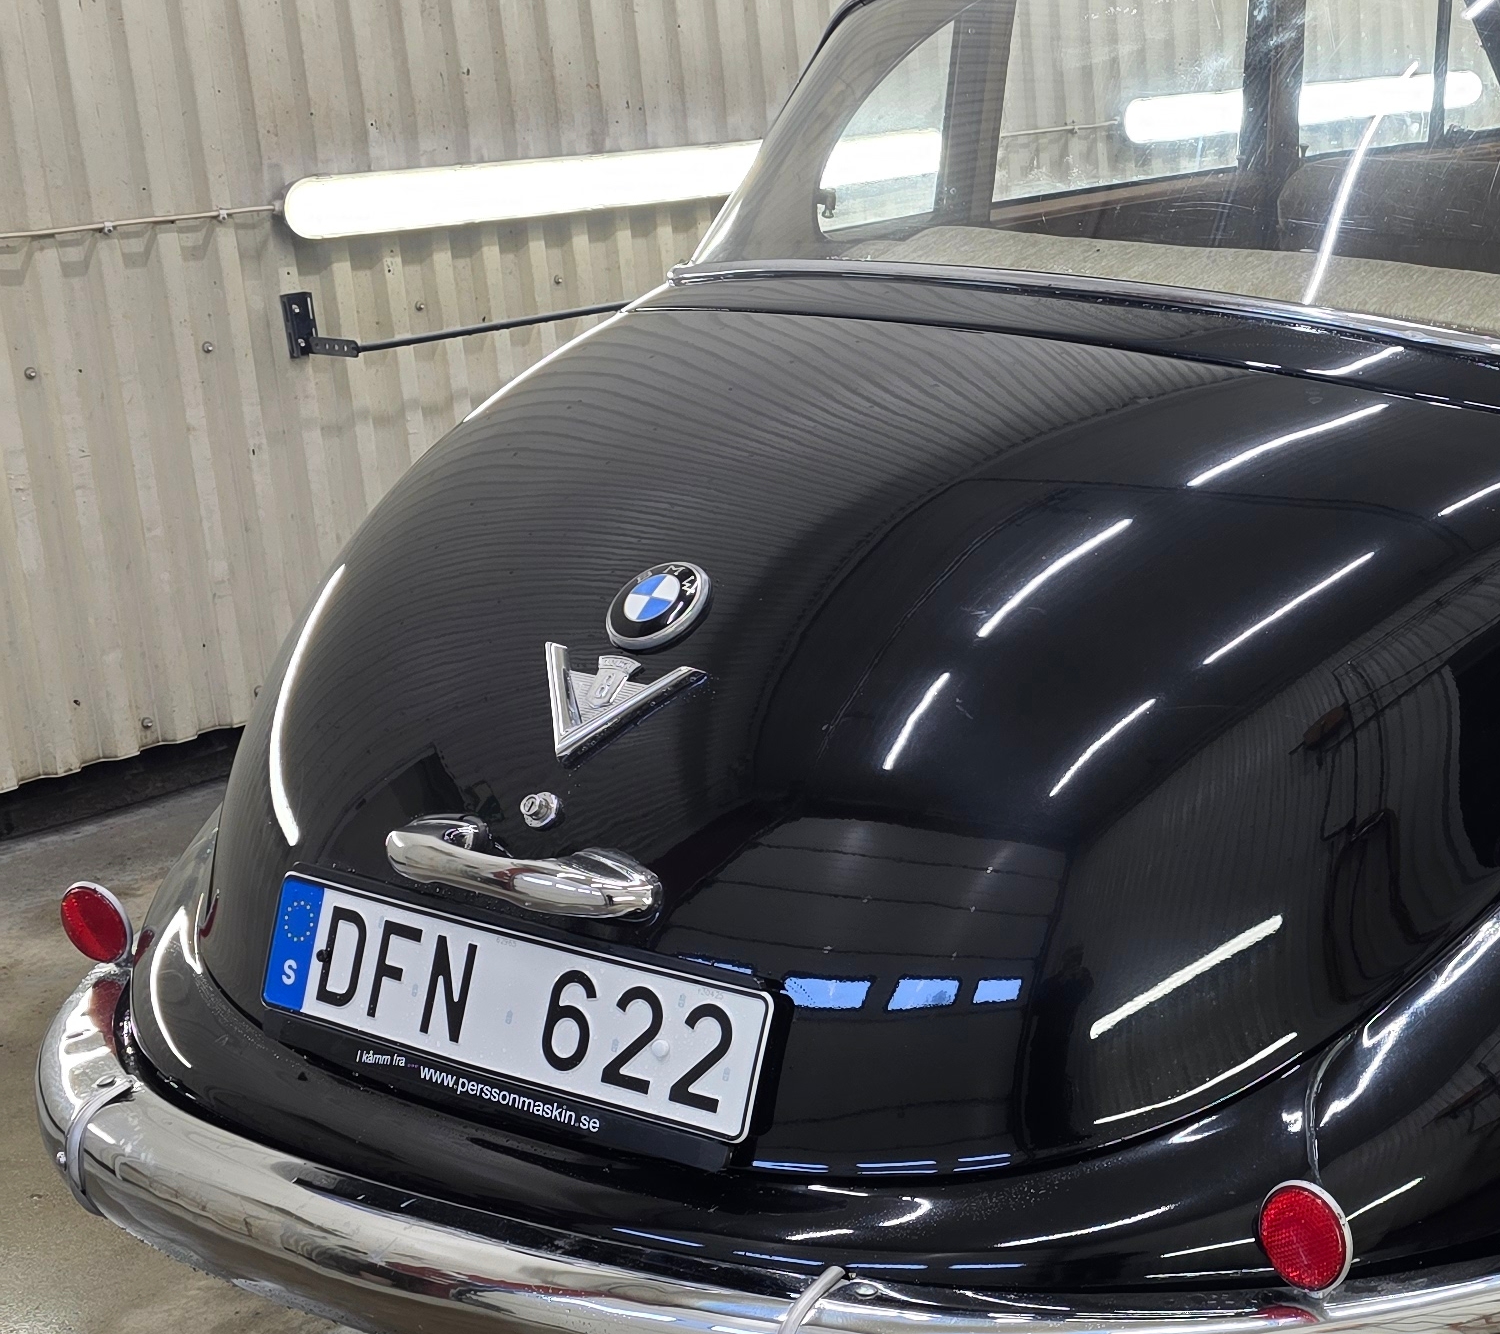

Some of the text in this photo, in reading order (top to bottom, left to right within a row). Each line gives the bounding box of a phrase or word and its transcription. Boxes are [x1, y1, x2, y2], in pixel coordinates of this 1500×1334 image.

[281, 958, 298, 986] S
[315, 905, 733, 1115] DFN 622
[420, 1065, 600, 1133] www.perssonmaskin.se
